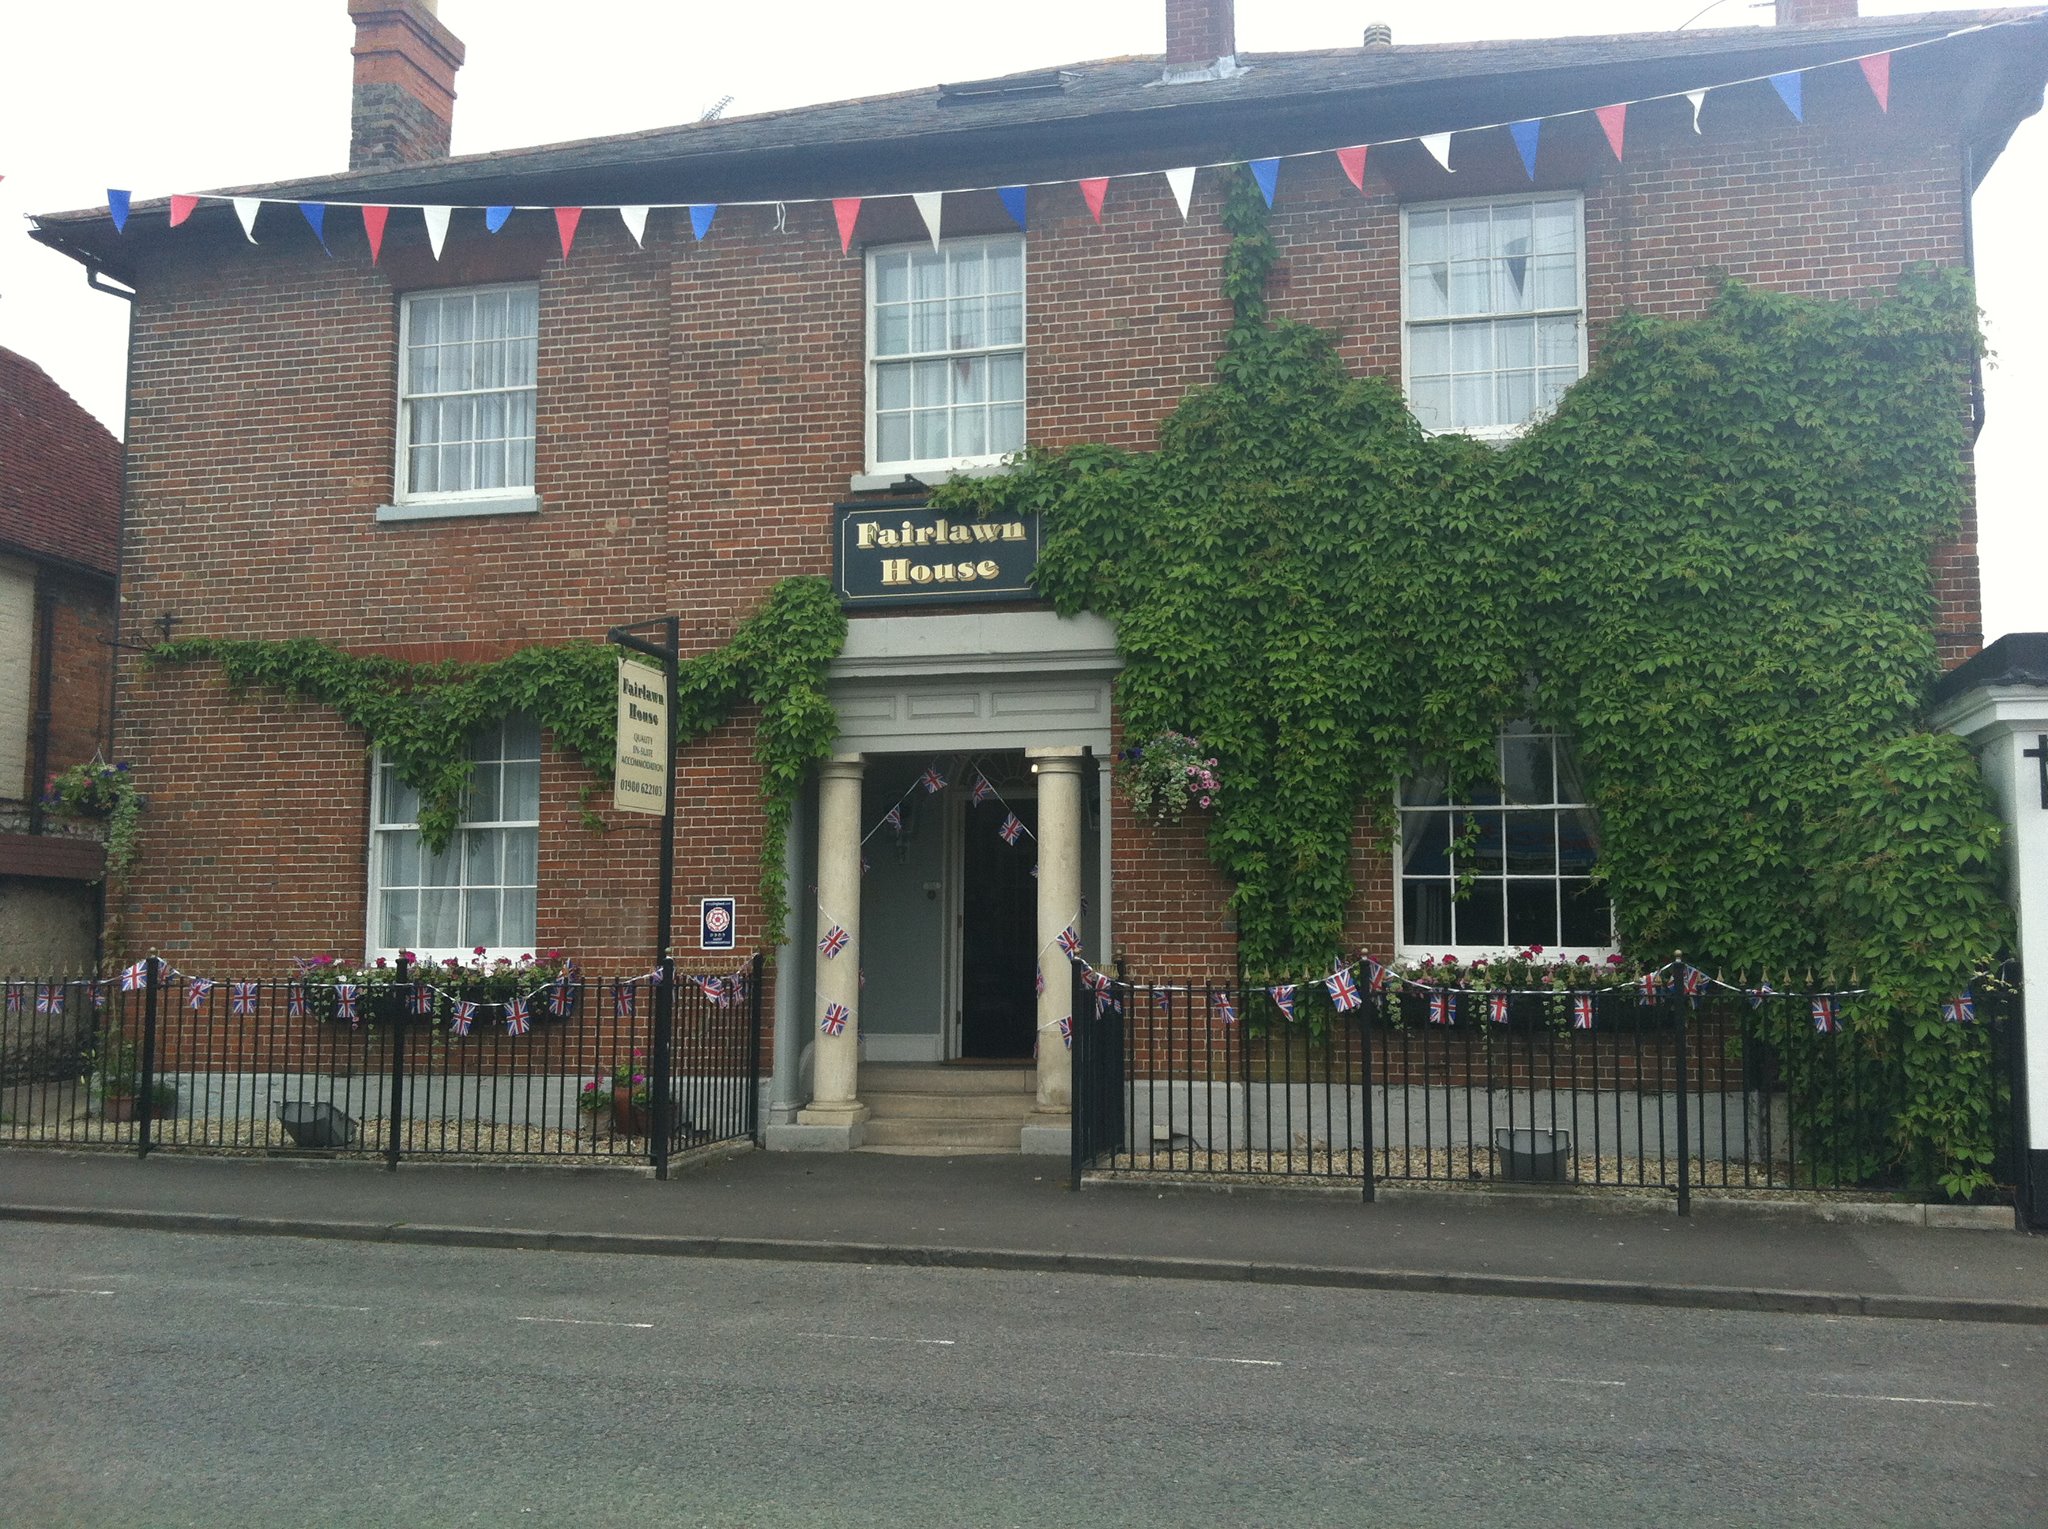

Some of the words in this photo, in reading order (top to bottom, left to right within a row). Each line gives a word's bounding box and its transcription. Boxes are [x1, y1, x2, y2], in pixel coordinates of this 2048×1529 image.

[856, 518, 1027, 549] Fairlawn
[880, 558, 1000, 586] House
[623, 677, 664, 706] Fairlawn
[629, 702, 659, 726] House
[640, 782, 663, 797] 622103
